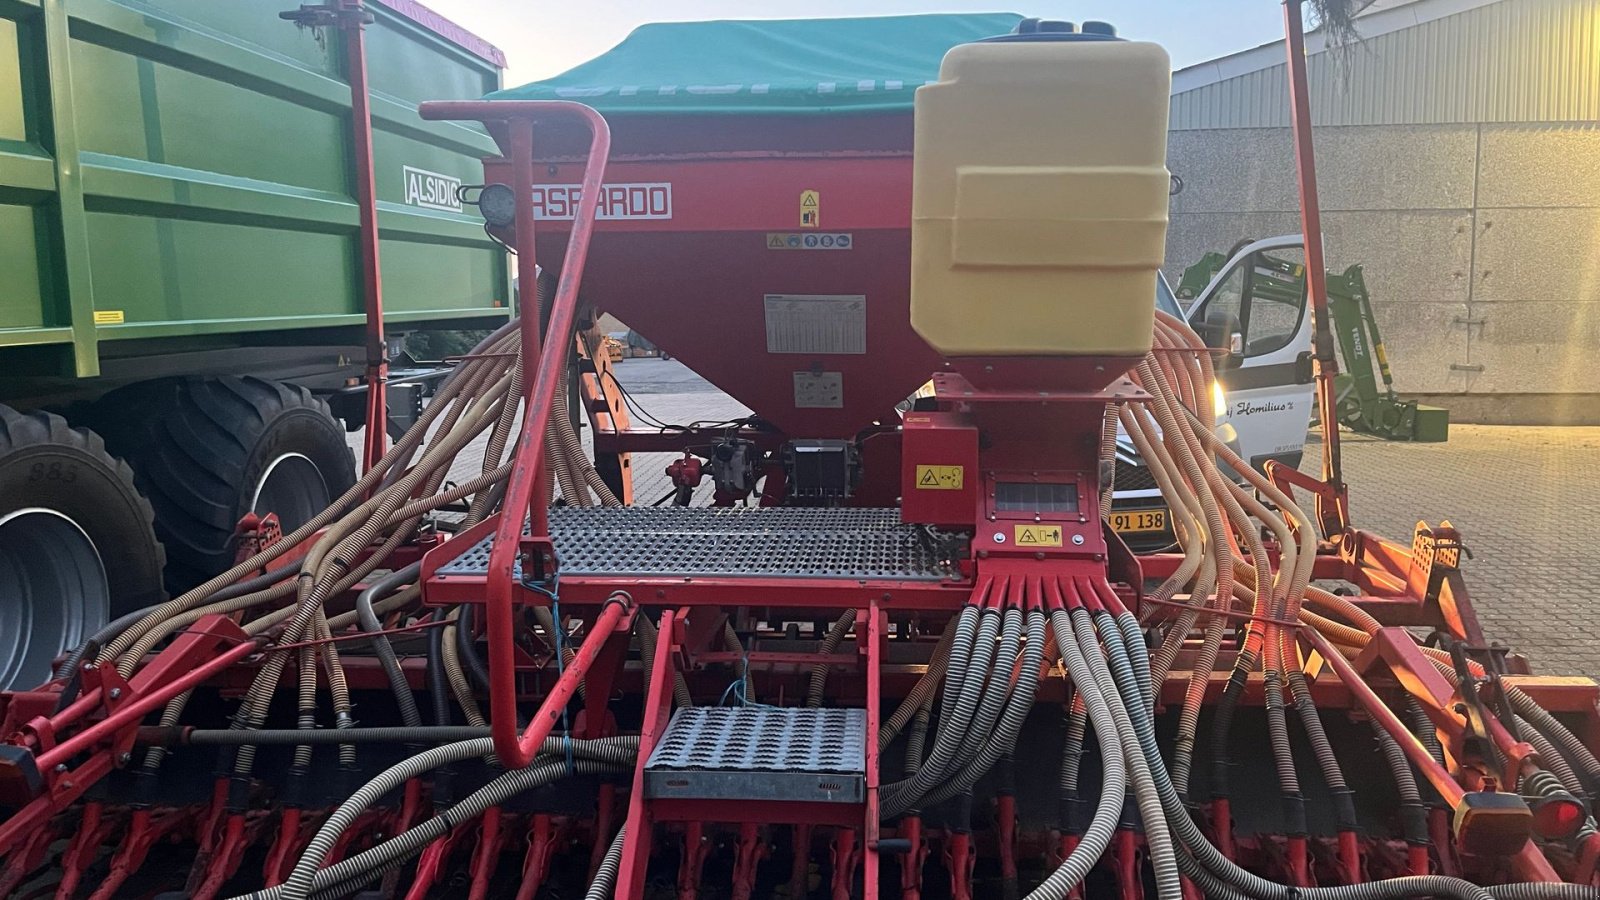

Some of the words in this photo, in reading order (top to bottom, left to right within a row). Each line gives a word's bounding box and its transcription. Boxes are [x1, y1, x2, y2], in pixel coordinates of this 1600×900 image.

[532, 187, 668, 217] ASPARDO
[1236, 402, 1286, 416] Homilius
[1115, 515, 1131, 530] 91
[1138, 513, 1163, 529] 138
